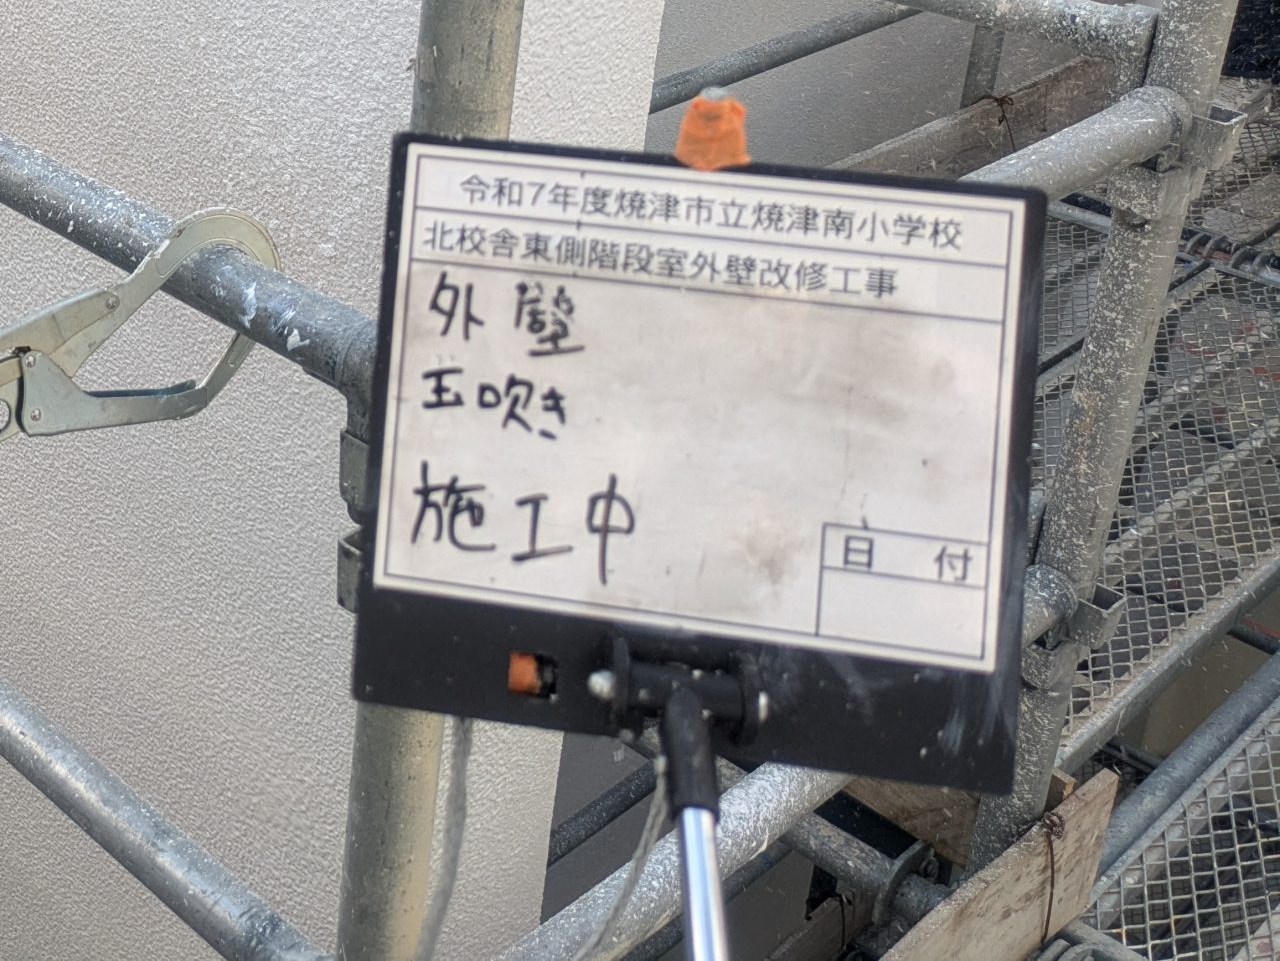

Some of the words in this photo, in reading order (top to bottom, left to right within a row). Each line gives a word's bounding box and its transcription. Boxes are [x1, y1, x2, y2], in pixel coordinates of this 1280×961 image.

[459, 174, 962, 250] 令和7年度焼津市立焼津南小学校
[423, 219, 899, 299] 北校舎東側階段室外壁改修工事
[429, 271, 585, 357] 外壁
[421, 366, 567, 440] 玉吹き
[411, 460, 635, 585] 施工中
